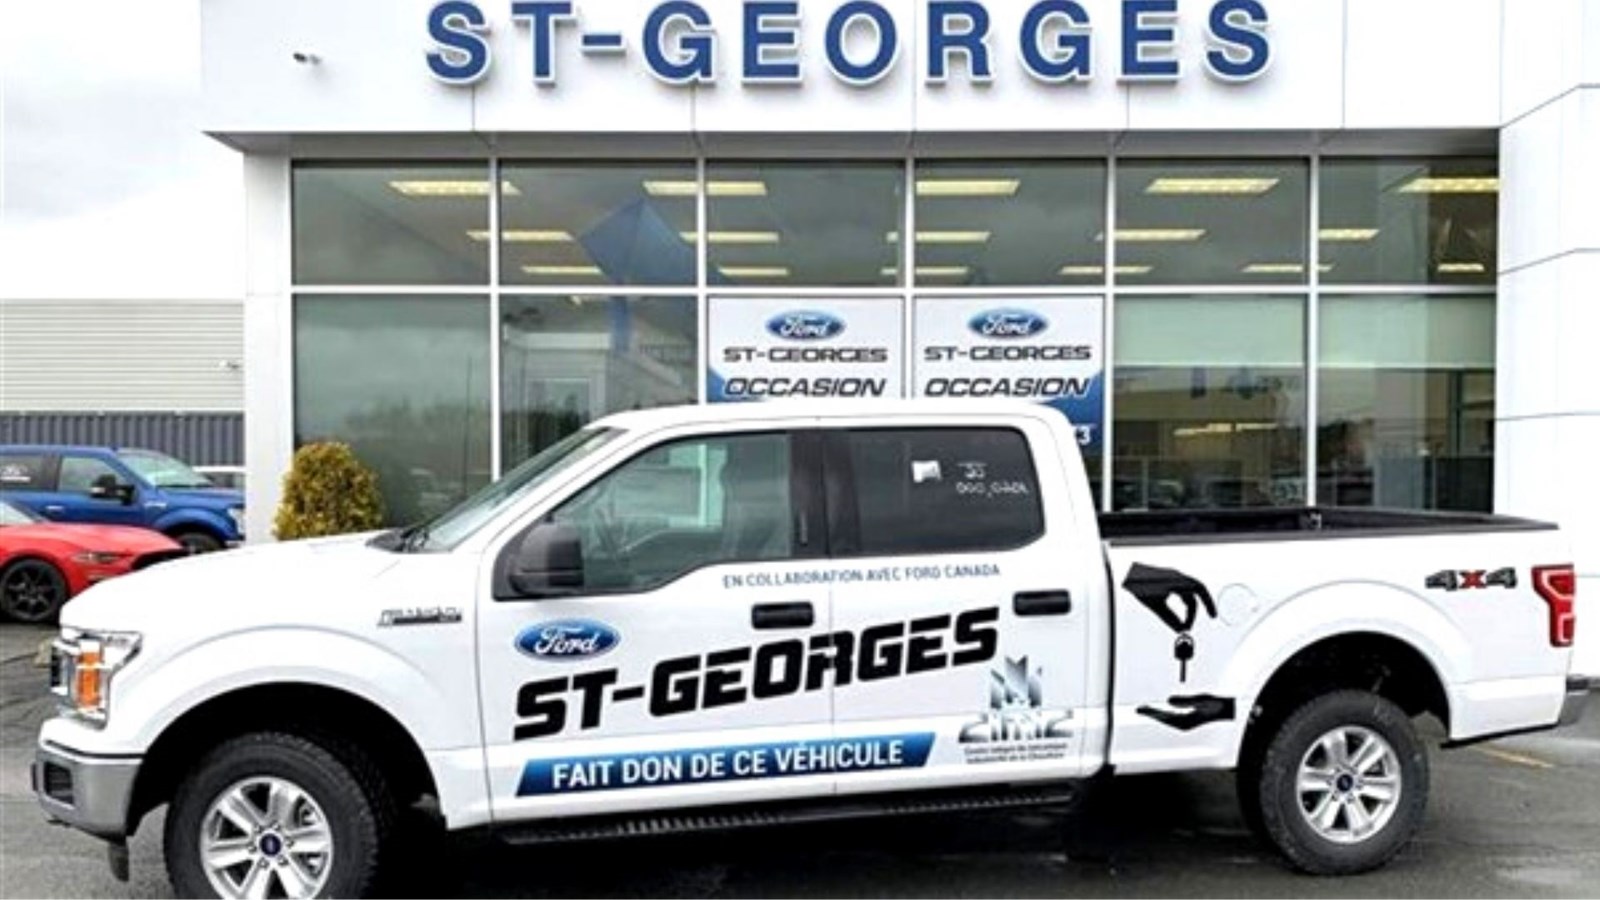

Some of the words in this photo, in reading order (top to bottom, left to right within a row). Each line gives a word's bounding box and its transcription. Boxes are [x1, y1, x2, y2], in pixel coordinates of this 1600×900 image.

[426, 0, 1271, 83] ST-GEORGES
[723, 346, 888, 363] ST-GEORGES
[924, 345, 1092, 361] ST-GEORGES
[724, 377, 886, 398] OCCASION
[924, 377, 1090, 397] OCCASION
[722, 574, 743, 588] EN
[746, 569, 863, 587] COLLABORATION
[866, 567, 902, 582] AVEC
[905, 565, 942, 580] FORD
[943, 564, 1001, 578] CANADA
[513, 605, 1000, 741] ST-GEORGES
[552, 761, 614, 789] FAIT
[622, 757, 682, 783] DON
[689, 754, 726, 778] DE
[732, 750, 768, 775] CE
[774, 739, 902, 771] VÉHICULE
